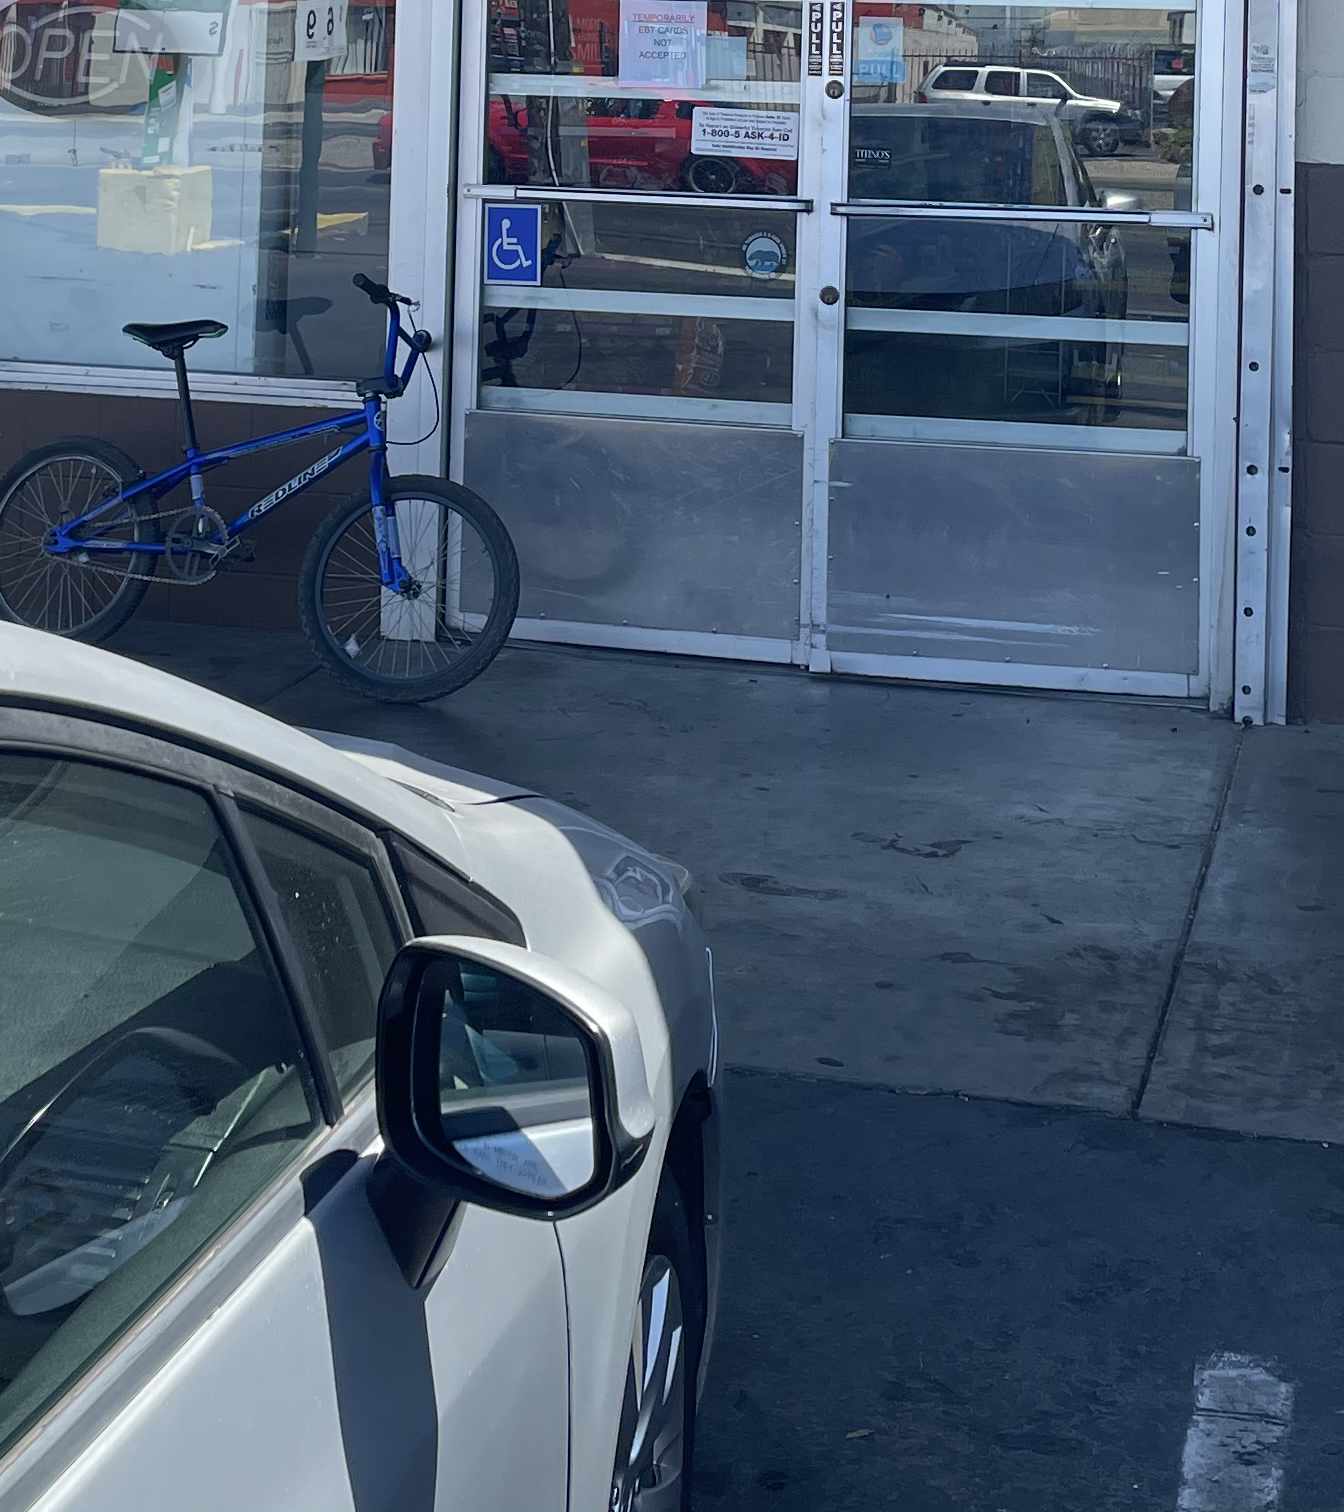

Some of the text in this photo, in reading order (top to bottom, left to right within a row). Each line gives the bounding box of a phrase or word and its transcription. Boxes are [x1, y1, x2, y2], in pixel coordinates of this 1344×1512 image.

[632, 13, 695, 22] TEMPORARILY
[638, 26, 689, 35] EBT CARDS
[811, 11, 822, 55] PULL
[831, 11, 843, 55] PULL
[653, 38, 672, 47] NOT
[638, 51, 687, 60] ACCEPTED
[859, 62, 901, 78] PULL
[701, 128, 790, 142] 1-800-5 ASK-4-ID
[248, 454, 330, 519] REDLINE
